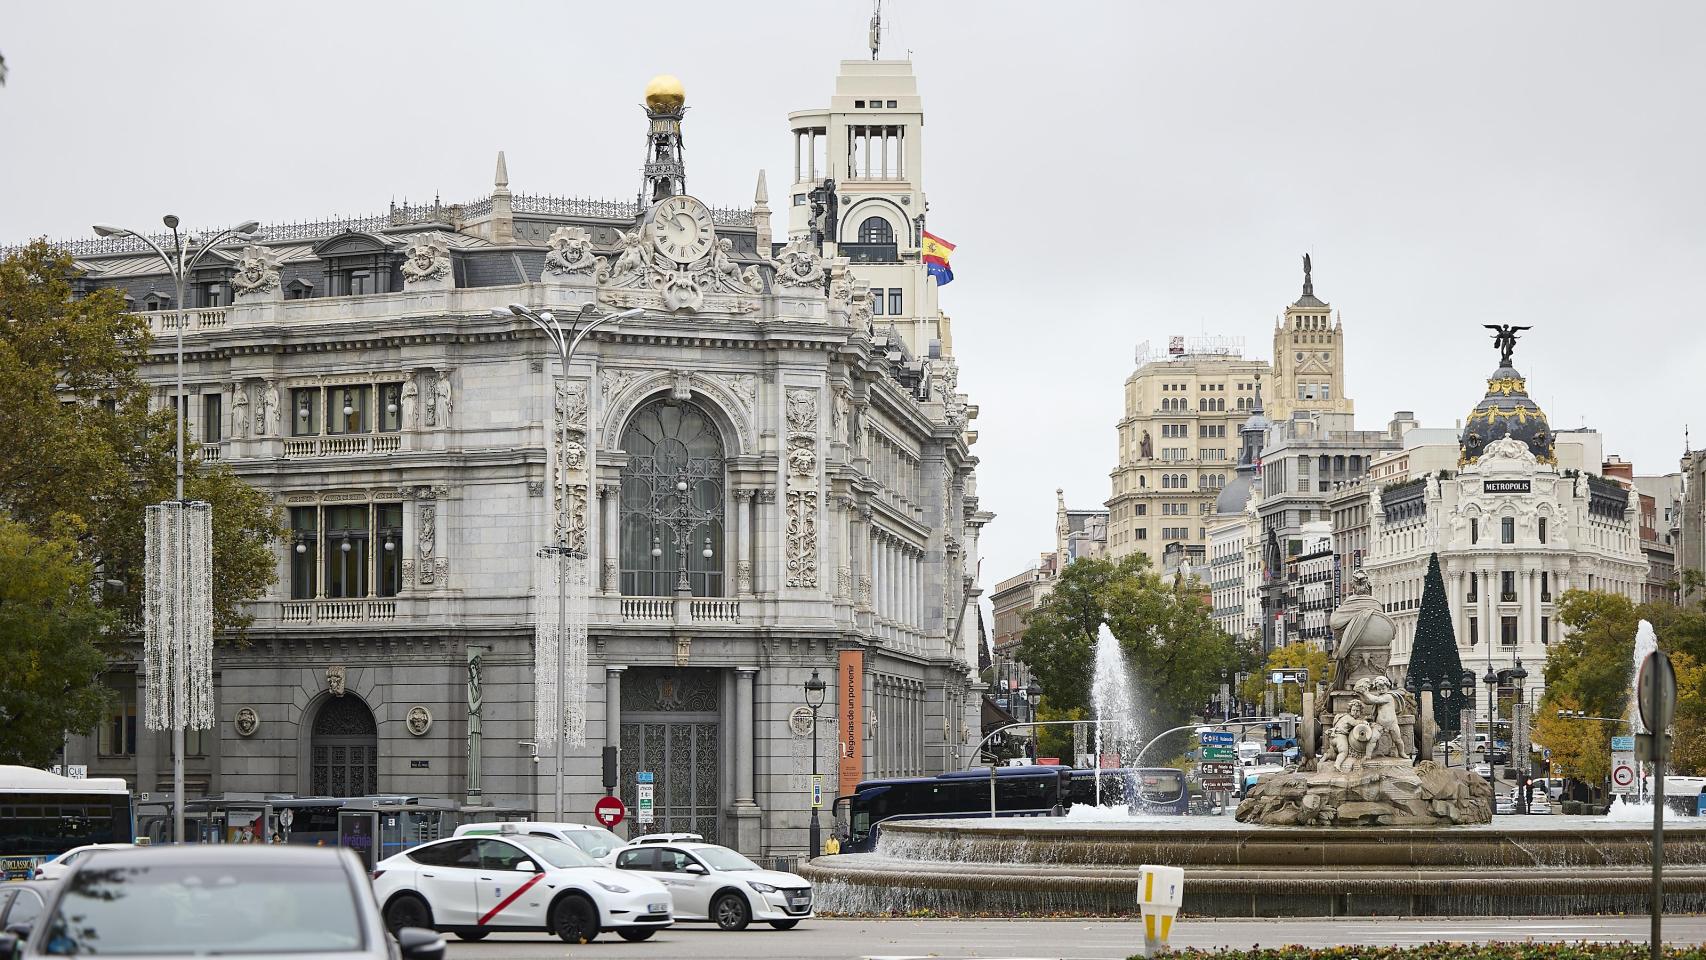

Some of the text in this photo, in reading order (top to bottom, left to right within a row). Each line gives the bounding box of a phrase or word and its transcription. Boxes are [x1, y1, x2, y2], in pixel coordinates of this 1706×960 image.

[1485, 483, 1529, 491] METROPOLIS
[847, 664, 856, 698] porvenir
[848, 698, 855, 709] un
[847, 710, 855, 721] de
